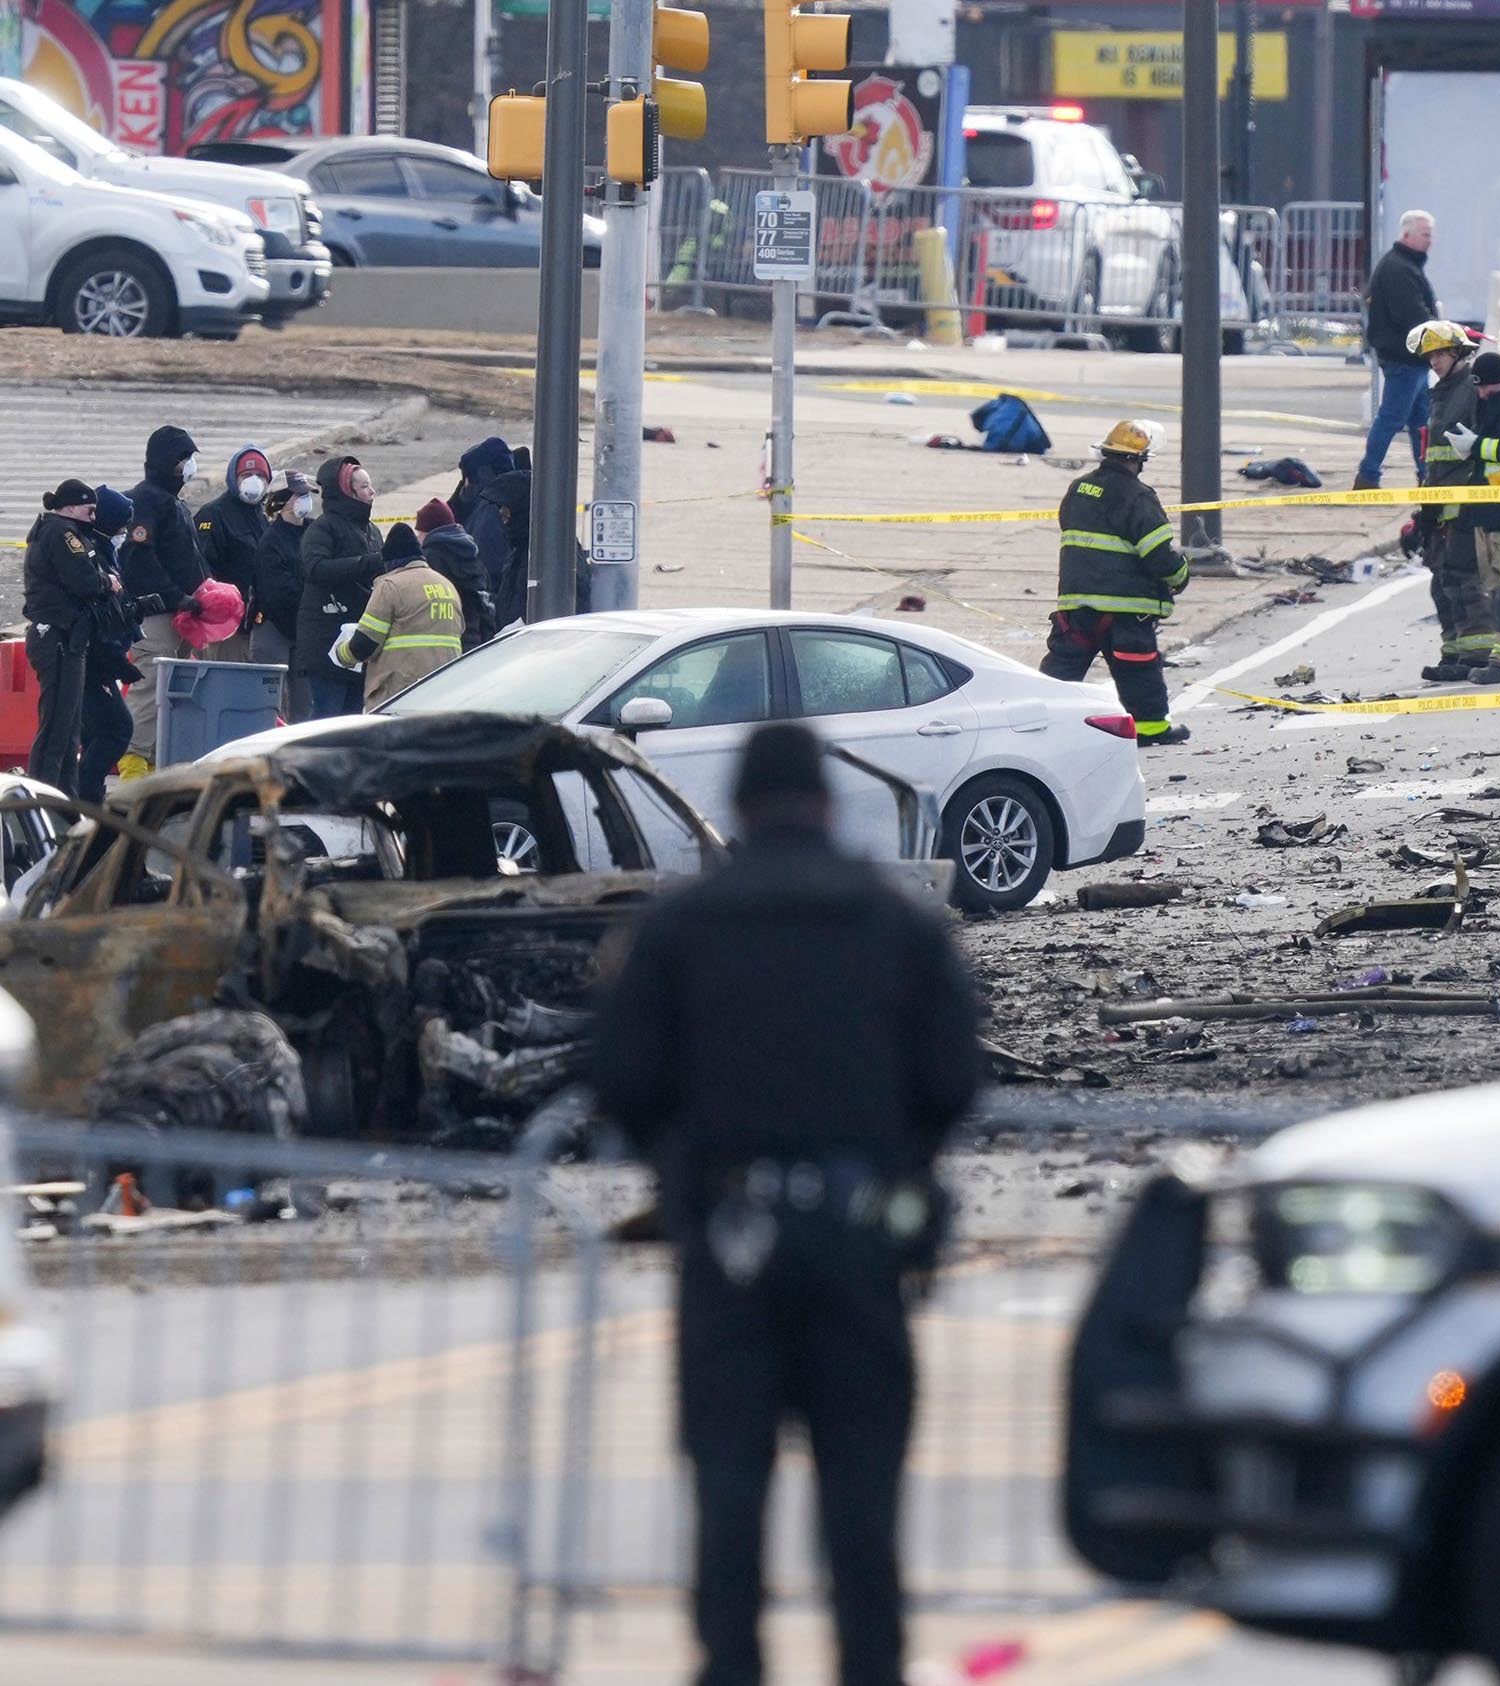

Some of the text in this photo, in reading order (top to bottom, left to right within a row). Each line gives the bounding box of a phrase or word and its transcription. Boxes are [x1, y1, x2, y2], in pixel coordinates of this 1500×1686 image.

[118, 64, 159, 146] KEN
[758, 212, 777, 228] 70
[758, 230, 777, 246] 77
[758, 248, 776, 258] 400
[431, 602, 454, 620] FMO
